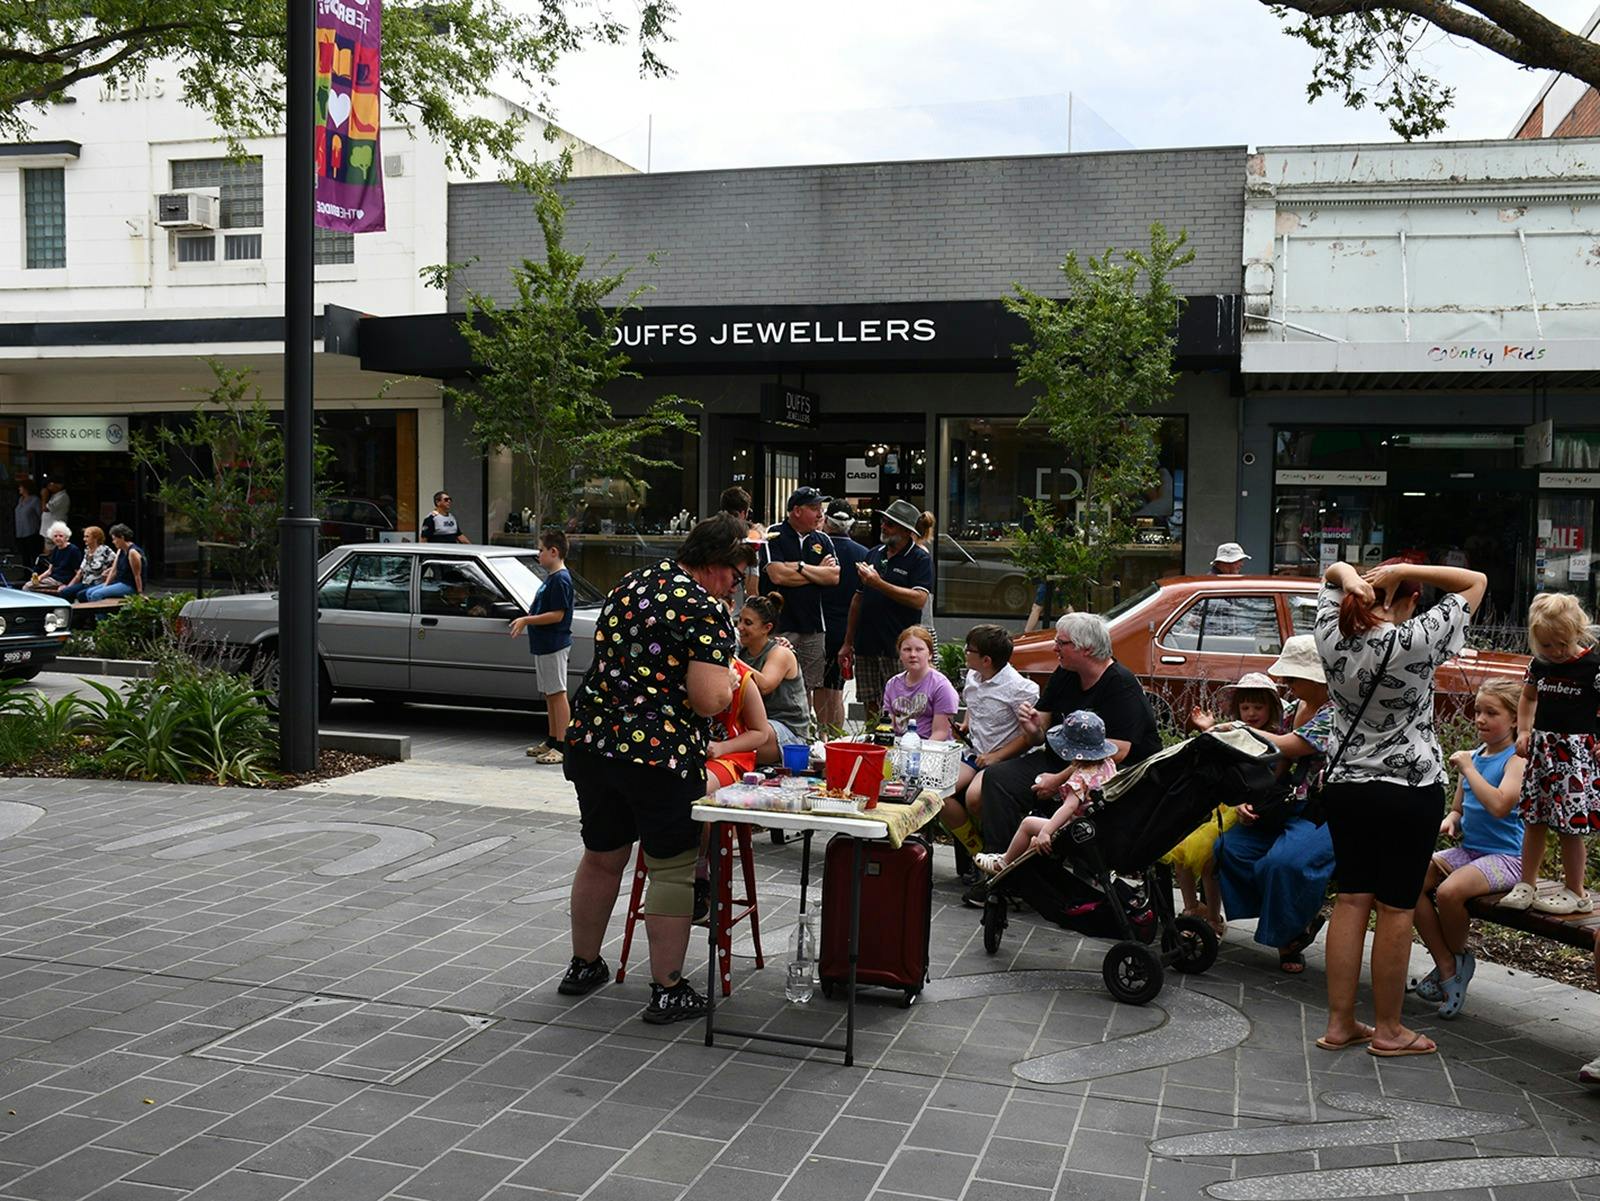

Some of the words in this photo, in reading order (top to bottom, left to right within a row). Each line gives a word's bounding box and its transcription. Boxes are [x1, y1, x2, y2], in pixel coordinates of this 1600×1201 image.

[709, 318, 937, 345] JEWELLERS
[1502, 344, 1547, 361] Kids
[31, 428, 68, 439] MESSER
[69, 428, 78, 439] &
[79, 428, 101, 439] OPIE
[846, 472, 877, 480] CASIO
